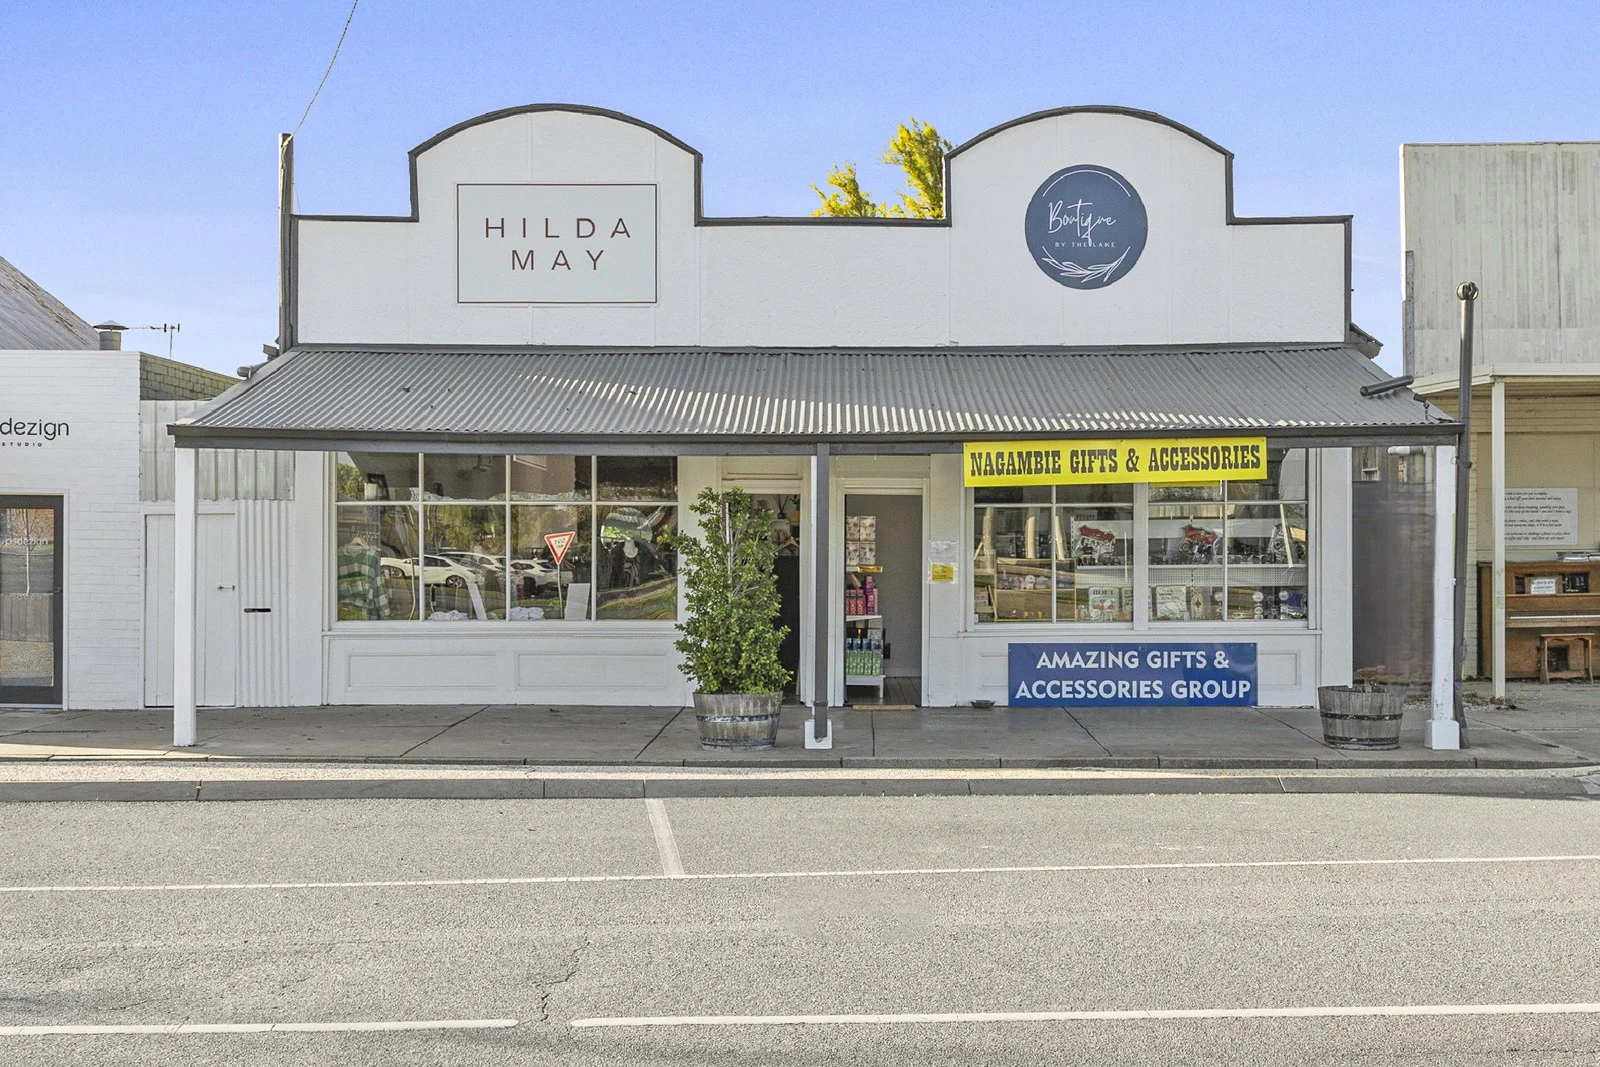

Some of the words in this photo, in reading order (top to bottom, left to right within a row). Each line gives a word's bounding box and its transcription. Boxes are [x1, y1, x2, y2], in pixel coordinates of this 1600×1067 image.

[485, 217, 631, 239] HILDA
[1048, 199, 1117, 247] Boutique
[511, 249, 605, 271] MAY
[970, 450, 1062, 477] NAGAMBIE
[1070, 448, 1118, 474] GIFTS
[1126, 447, 1140, 473] &
[1148, 444, 1261, 472] ACCESSORIES
[1036, 650, 1140, 669] AMAZING
[1146, 650, 1207, 669] GIFTS
[1213, 650, 1230, 669] &
[1015, 679, 1164, 699] ACCESSORIES
[1171, 679, 1251, 699] GROUP
